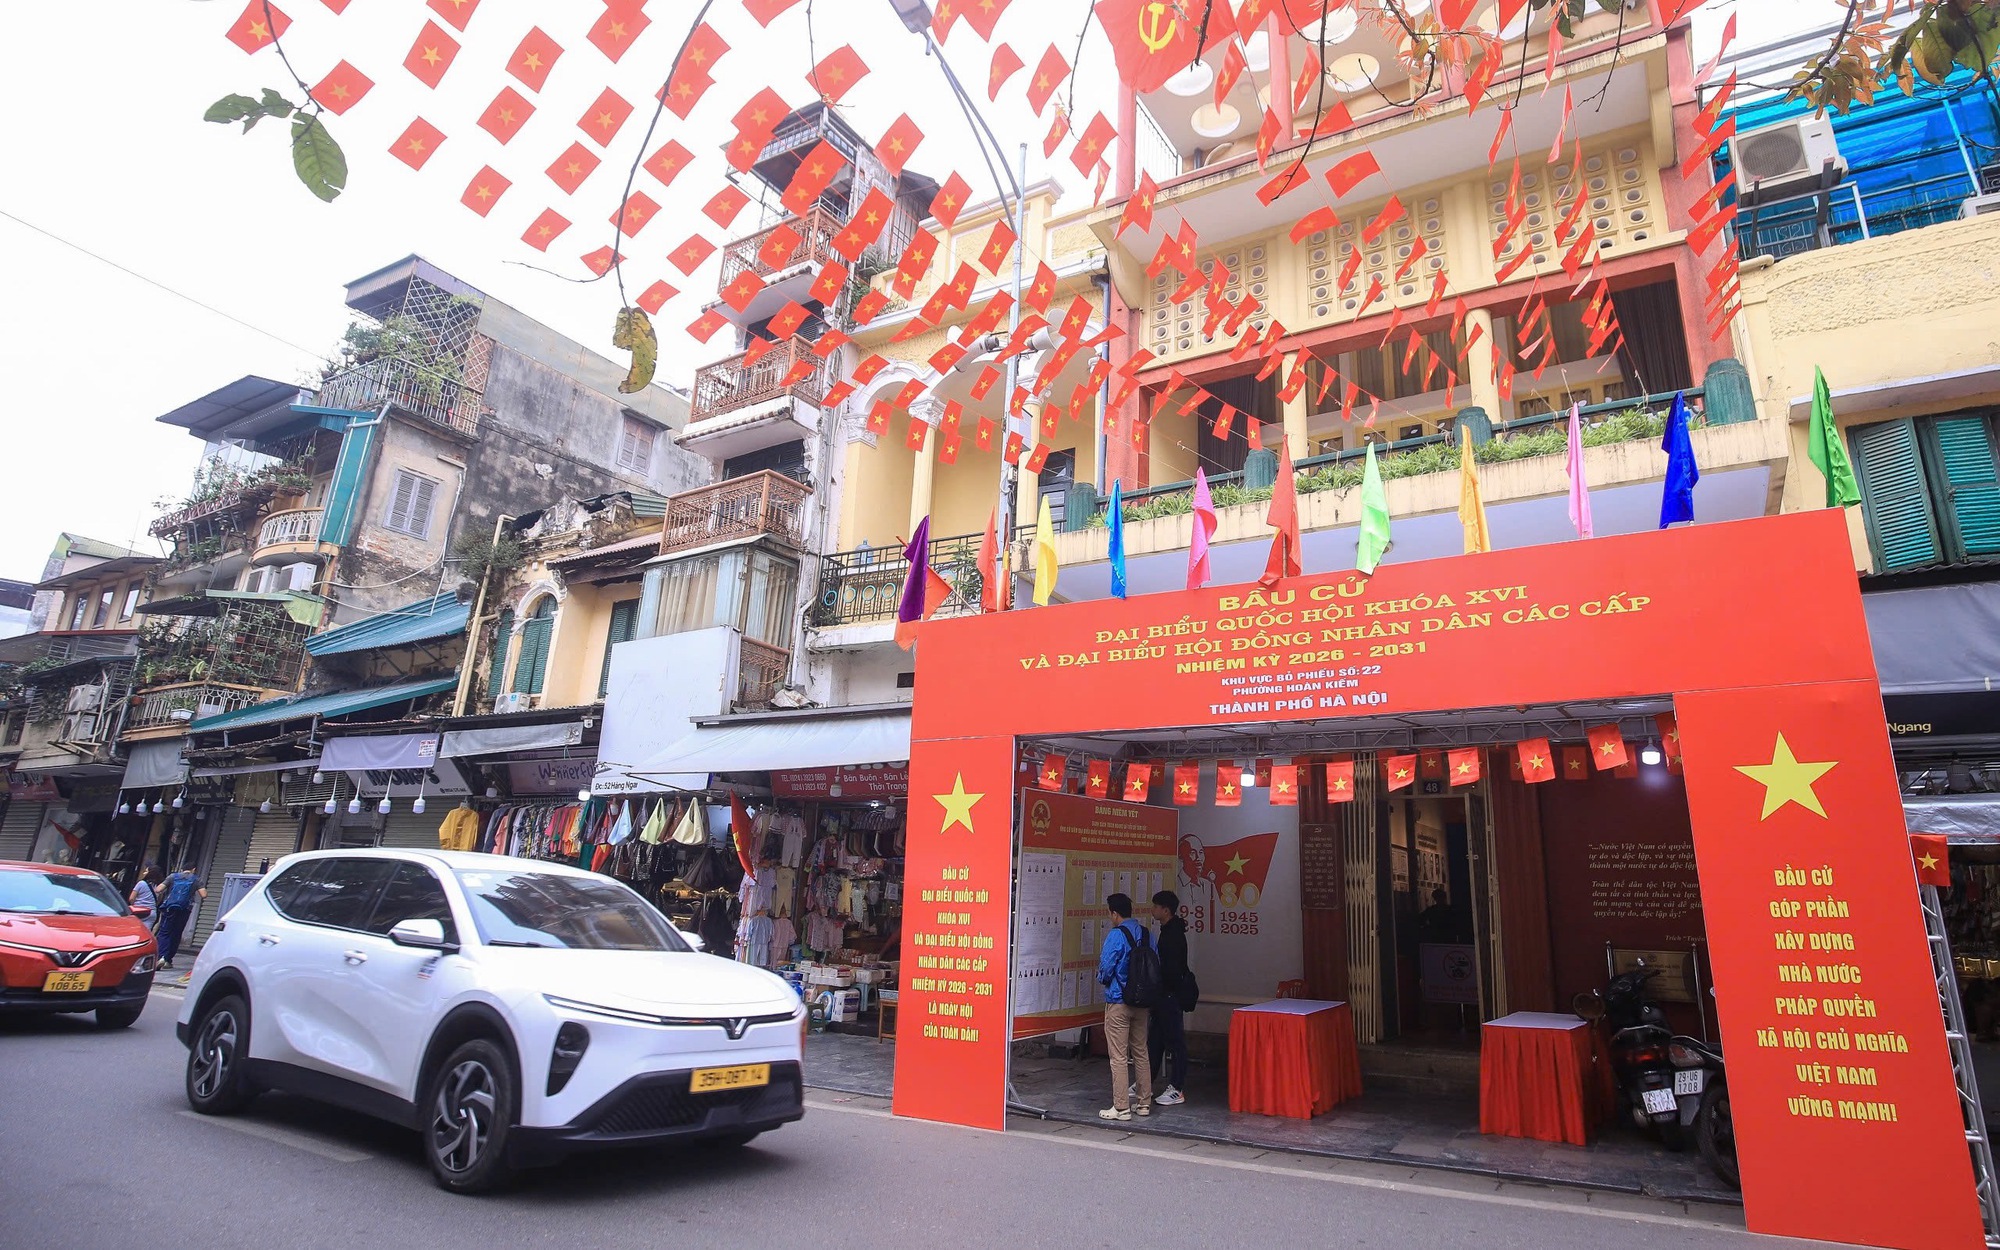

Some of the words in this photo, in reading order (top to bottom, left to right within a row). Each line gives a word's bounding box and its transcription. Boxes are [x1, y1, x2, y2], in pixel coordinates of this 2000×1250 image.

[1219, 587, 1295, 611] BẦU
[1309, 577, 1369, 602] CỬ
[1095, 628, 1139, 645] ĐẠI
[1147, 615, 1208, 639] BIỂU
[1216, 608, 1293, 631] QUỐC
[1300, 603, 1354, 625] HỘI
[1364, 592, 1456, 616] KHÓA
[1465, 585, 1529, 605] XVI
[1020, 653, 1051, 670] VÀ
[1058, 652, 1100, 668] ĐẠI
[1107, 639, 1166, 663] BIỂU
[1174, 637, 1222, 657] HỘI
[1231, 629, 1313, 651] ĐỒNG
[1321, 621, 1411, 643] NHÂN
[1421, 612, 1492, 633] DÂN
[1502, 605, 1570, 624] CÁC
[1579, 591, 1651, 617] CẤP
[1176, 657, 1246, 674] NHIỆM
[1253, 653, 1280, 668] KỲ
[1288, 649, 1344, 665] 2026
[1369, 641, 1426, 658] 2031
[1221, 677, 1246, 686] KHU
[1249, 674, 1272, 685] VỰC
[1276, 671, 1293, 682] BỎ
[1297, 667, 1335, 680] PHIẾU
[1233, 685, 1282, 696] PHƯỜNG
[1286, 682, 1322, 693] HOÀN
[1325, 677, 1359, 689] KIẾM
[1209, 701, 1269, 715] THÀNH
[1275, 694, 1313, 711] PHỐ
[1319, 694, 1346, 708] HÀ
[1352, 691, 1388, 706] NỘI
[1887, 722, 1932, 735] Ngang
[886, 782, 907, 791] Trang
[1426, 782, 1438, 793] 48
[1621, 843, 1635, 851] Việt
[1668, 840, 1691, 851] quyền
[942, 864, 957, 880] BẦU
[959, 865, 970, 880] CỬ
[1774, 863, 1807, 886] BẦU
[1811, 864, 1834, 886] CỬ
[1591, 880, 1609, 888] Toàn
[1628, 880, 1642, 888] dân
[1662, 881, 1677, 889] Việt
[1680, 881, 1699, 889] Nam
[922, 889, 934, 904] ĐẠI
[936, 886, 952, 902] BIỂU
[954, 886, 974, 903] QUỐC
[975, 888, 989, 905] HỘI
[1220, 882, 1260, 909] 80
[1593, 909, 1616, 918] quyền
[1769, 898, 1801, 918] GÓP
[1805, 895, 1850, 918] PHẦN
[937, 910, 956, 925] KHÓA
[958, 912, 971, 925] XVI
[1220, 911, 1259, 923] 1945
[1220, 923, 1259, 935] 2025
[914, 931, 923, 945] VÀ
[925, 934, 937, 949] ĐẠI
[939, 930, 956, 947] BIỂU
[957, 933, 970, 950] HỘI
[972, 932, 993, 949] ĐỒNG
[1774, 929, 1804, 950] XÂY
[1809, 931, 1855, 954] DỰNG
[918, 954, 937, 969] NHÂN
[939, 955, 954, 970] DÂN
[956, 956, 970, 971] CÁC
[972, 954, 988, 972] CẤP
[60, 973, 80, 981] 29E
[1778, 962, 1812, 983] NHÀ
[1816, 962, 1862, 984] NƯỚC
[50, 982, 86, 990] 108.65
[912, 976, 935, 993] NHIỆM
[937, 977, 947, 992] KỲ
[948, 980, 966, 994] 2026
[974, 982, 993, 996] 2031
[928, 1000, 937, 1015] LÀ
[939, 1001, 958, 1016] NGÀY
[959, 1003, 973, 1020] HỘI
[1775, 994, 1818, 1016] PHÁP
[1822, 993, 1877, 1017] QUYỀN
[924, 1021, 938, 1038] CỦA
[940, 1024, 959, 1040] TOÀN
[960, 1026, 979, 1042] DÂN!
[1756, 1026, 1779, 1048] XÃ
[1782, 1027, 1812, 1052] HỘI
[1815, 1027, 1850, 1051] CHỦ
[1854, 1031, 1909, 1053] NGHĨA
[1678, 1070, 1698, 1082] 29-U6
[1795, 1061, 1831, 1087] VIỆT
[1836, 1066, 1878, 1086] NAM
[1678, 1082, 1698, 1093] 1208
[1787, 1094, 1834, 1118] VỮNG
[1837, 1100, 1898, 1124] MẠNH!
